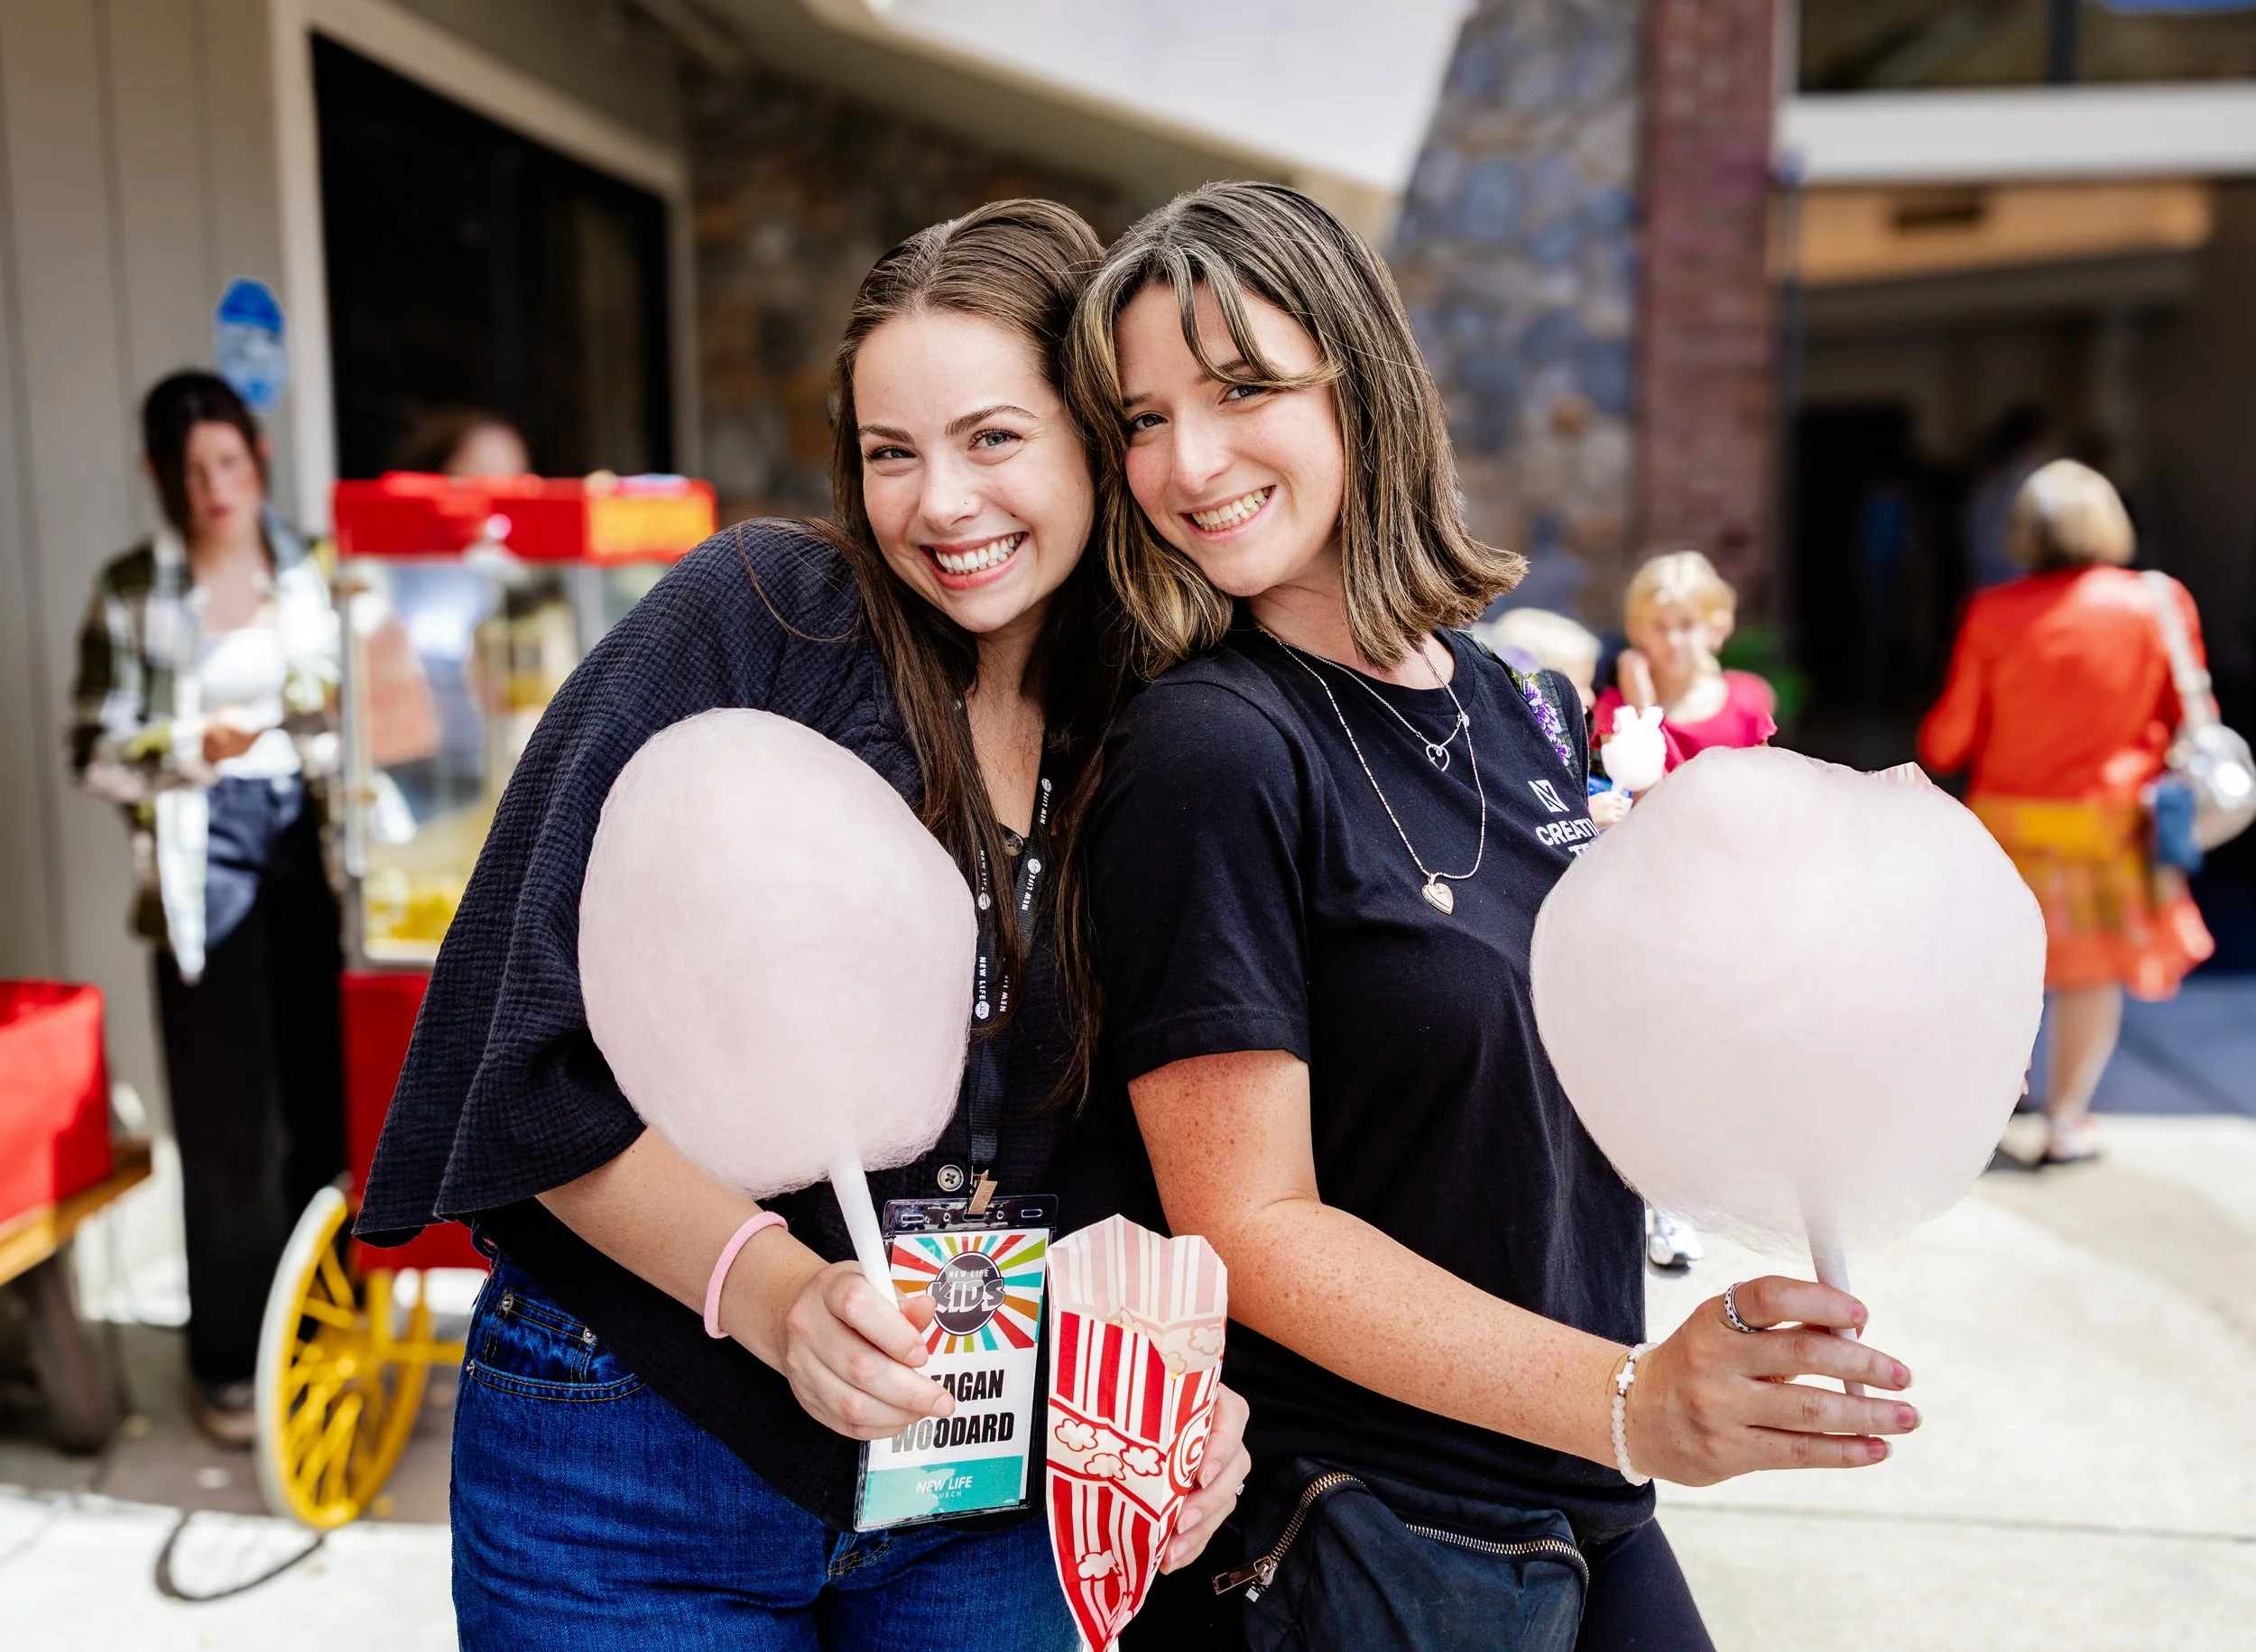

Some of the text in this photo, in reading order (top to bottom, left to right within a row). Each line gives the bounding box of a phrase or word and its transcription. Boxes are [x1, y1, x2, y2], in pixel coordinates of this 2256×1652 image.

[1041, 790, 1049, 808] LIFE
[1040, 807, 1048, 825] NEW
[1021, 891, 1031, 911] NEW
[1026, 872, 1036, 891] LIFE
[978, 956, 987, 1001] NEW LIFE
[999, 992, 1009, 1012] NEW
[948, 1269, 990, 1279] NEW LIFE
[927, 1278, 1005, 1314] KIDS
[930, 1369, 1005, 1403] AGAN
[892, 1411, 1015, 1454] WOODARD
[915, 1475, 974, 1494] NEW LIFE
[927, 1490, 962, 1500] CHURCH
